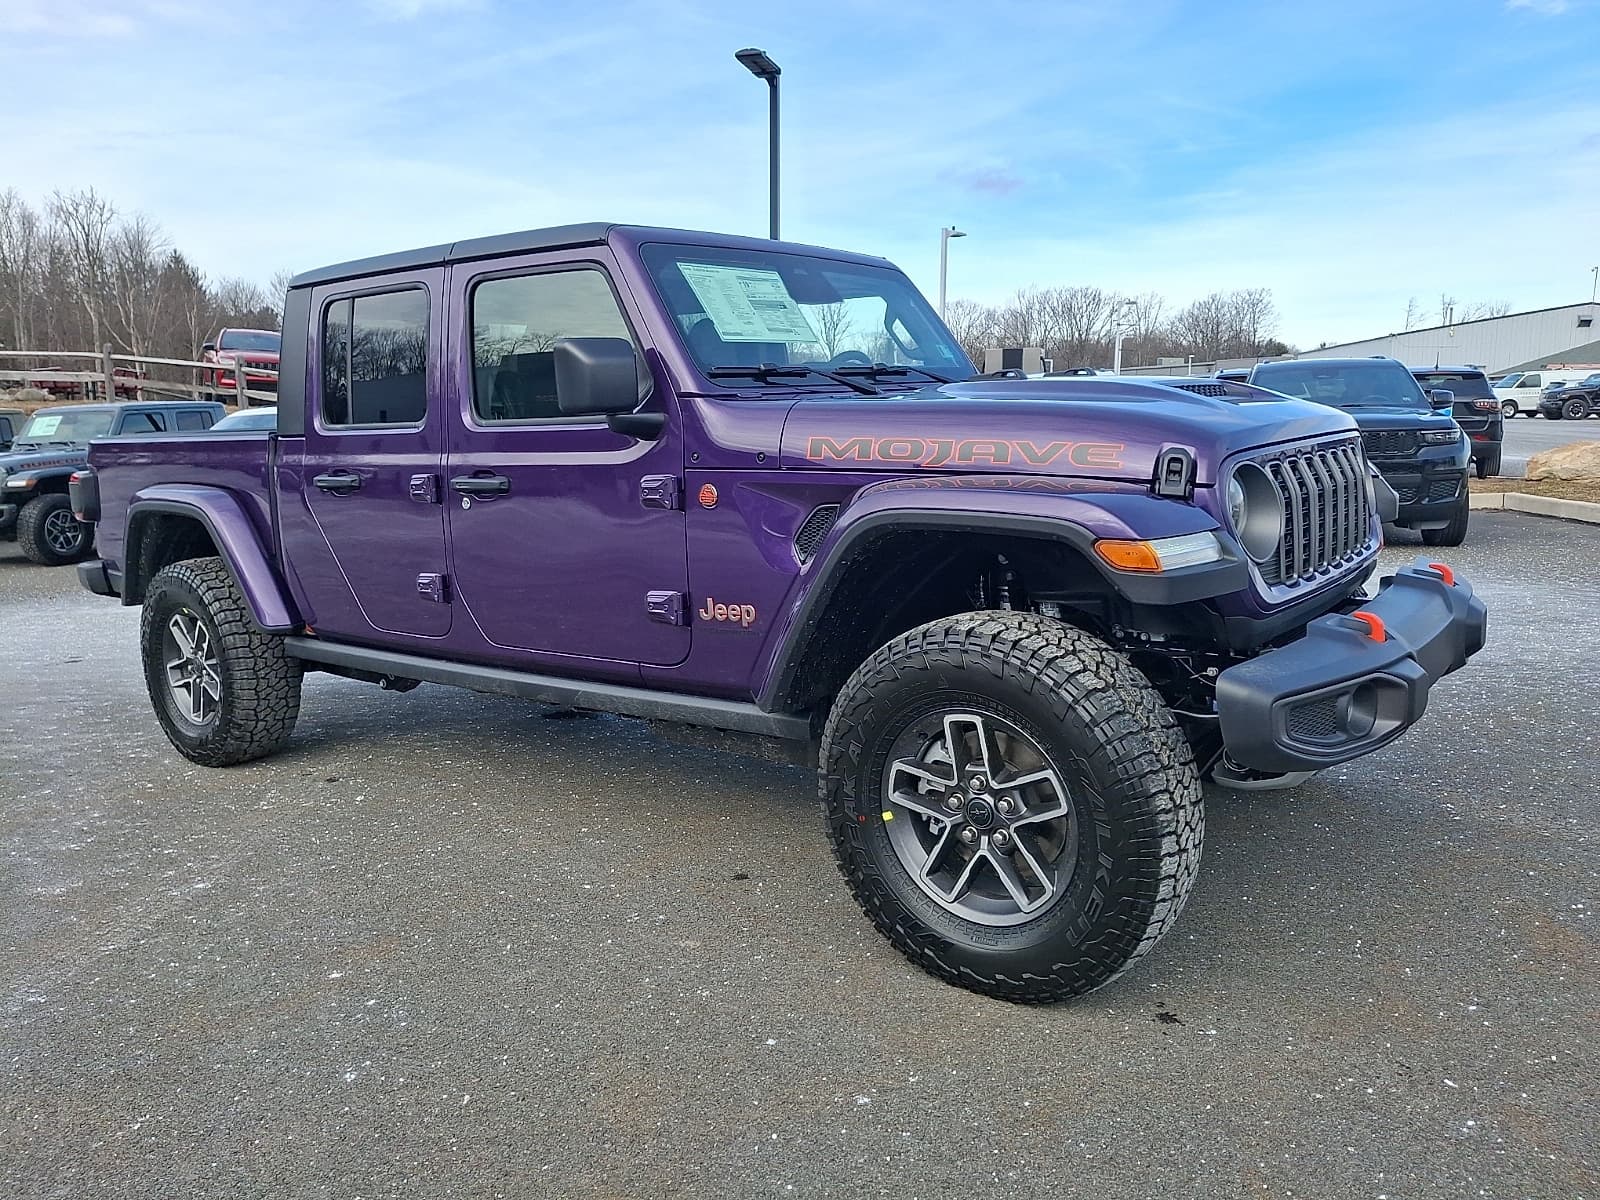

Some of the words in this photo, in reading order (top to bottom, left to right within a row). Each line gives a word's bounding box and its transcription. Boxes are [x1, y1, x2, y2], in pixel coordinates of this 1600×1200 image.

[806, 436, 1124, 467] MOJAVE
[699, 597, 756, 628] Jeep
[1066, 749, 1114, 947] FALKEN
